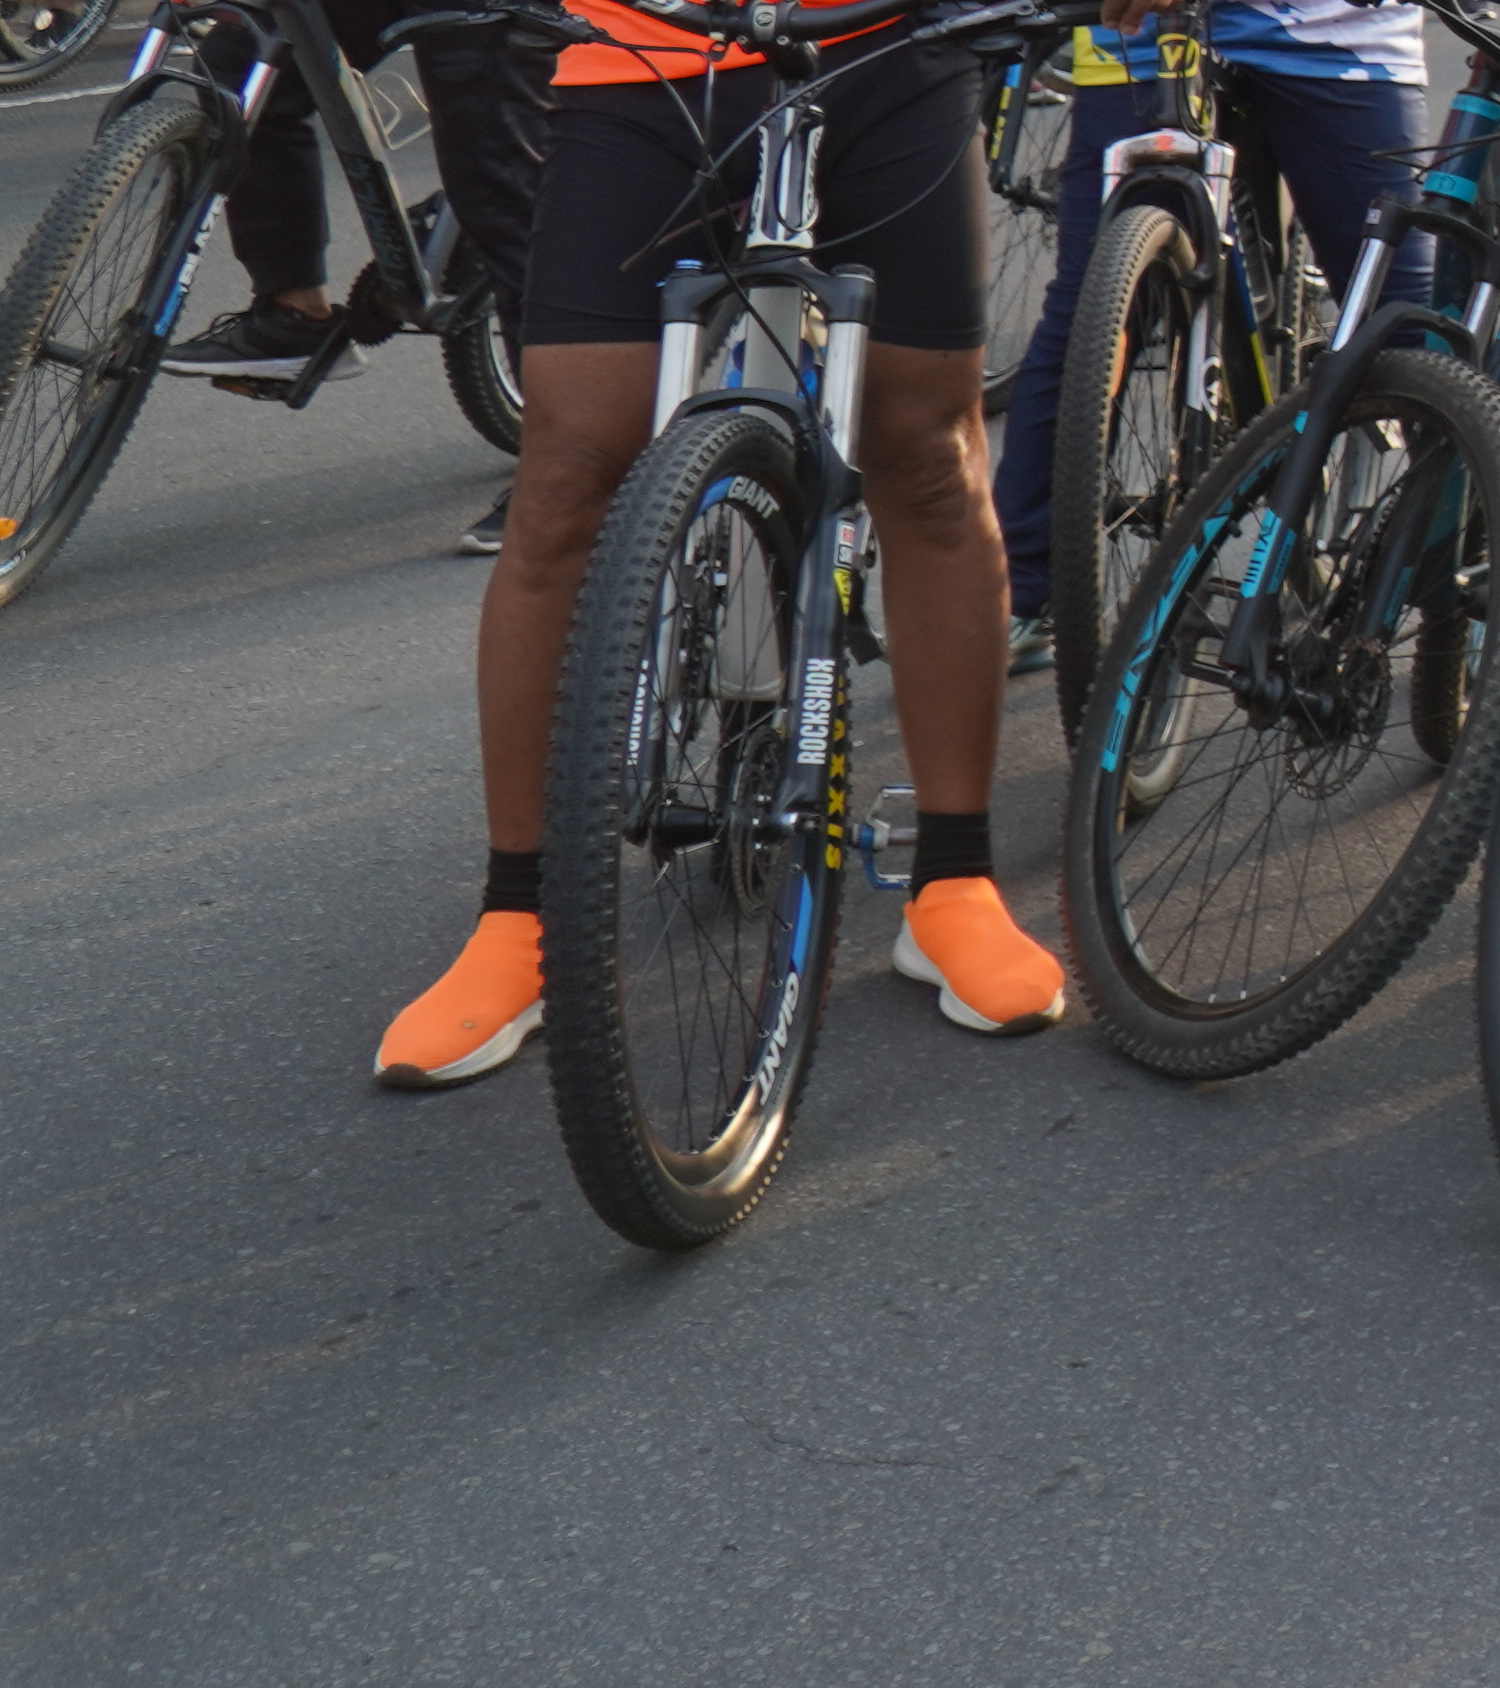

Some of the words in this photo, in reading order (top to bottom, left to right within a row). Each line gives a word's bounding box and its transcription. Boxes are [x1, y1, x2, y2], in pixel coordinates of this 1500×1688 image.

[725, 474, 780, 519] GIANT
[796, 658, 836, 765] ROCKSHOX
[759, 971, 799, 1106] GIANT
